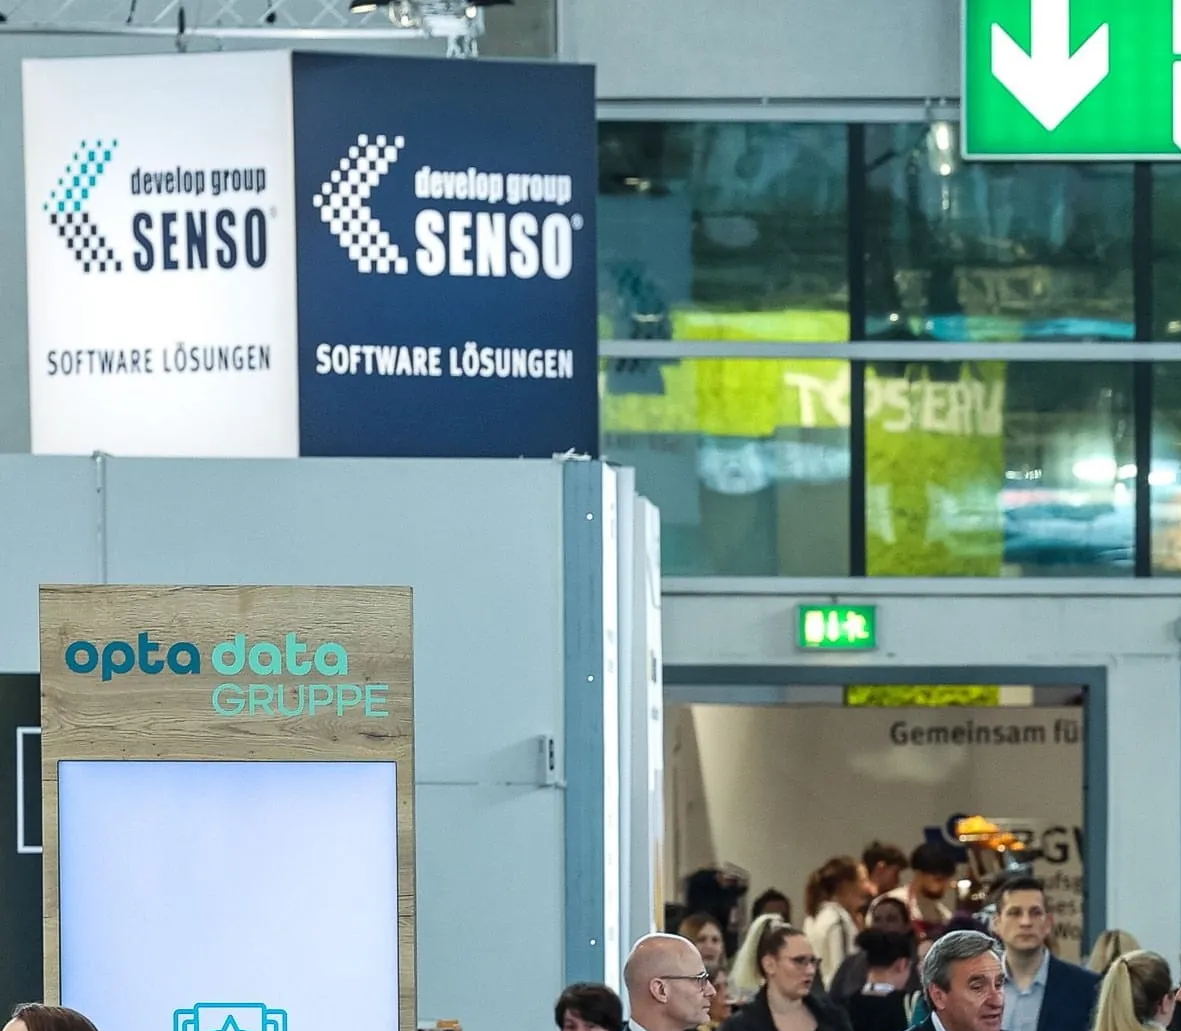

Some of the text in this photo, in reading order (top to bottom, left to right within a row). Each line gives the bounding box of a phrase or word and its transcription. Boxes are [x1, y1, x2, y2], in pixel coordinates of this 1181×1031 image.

[131, 166, 266, 196] develop group
[414, 166, 572, 205] develop group
[132, 208, 267, 272] SENSO
[48, 342, 271, 376] SOFTWARE LÖSUNGEN
[316, 341, 574, 378] SOFTWARE LÖSUNGEN
[65, 631, 348, 681] opta data
[211, 683, 389, 717] GRUPPE
[889, 720, 1046, 746] Gemeinsam
[1054, 718, 1084, 745] fü
